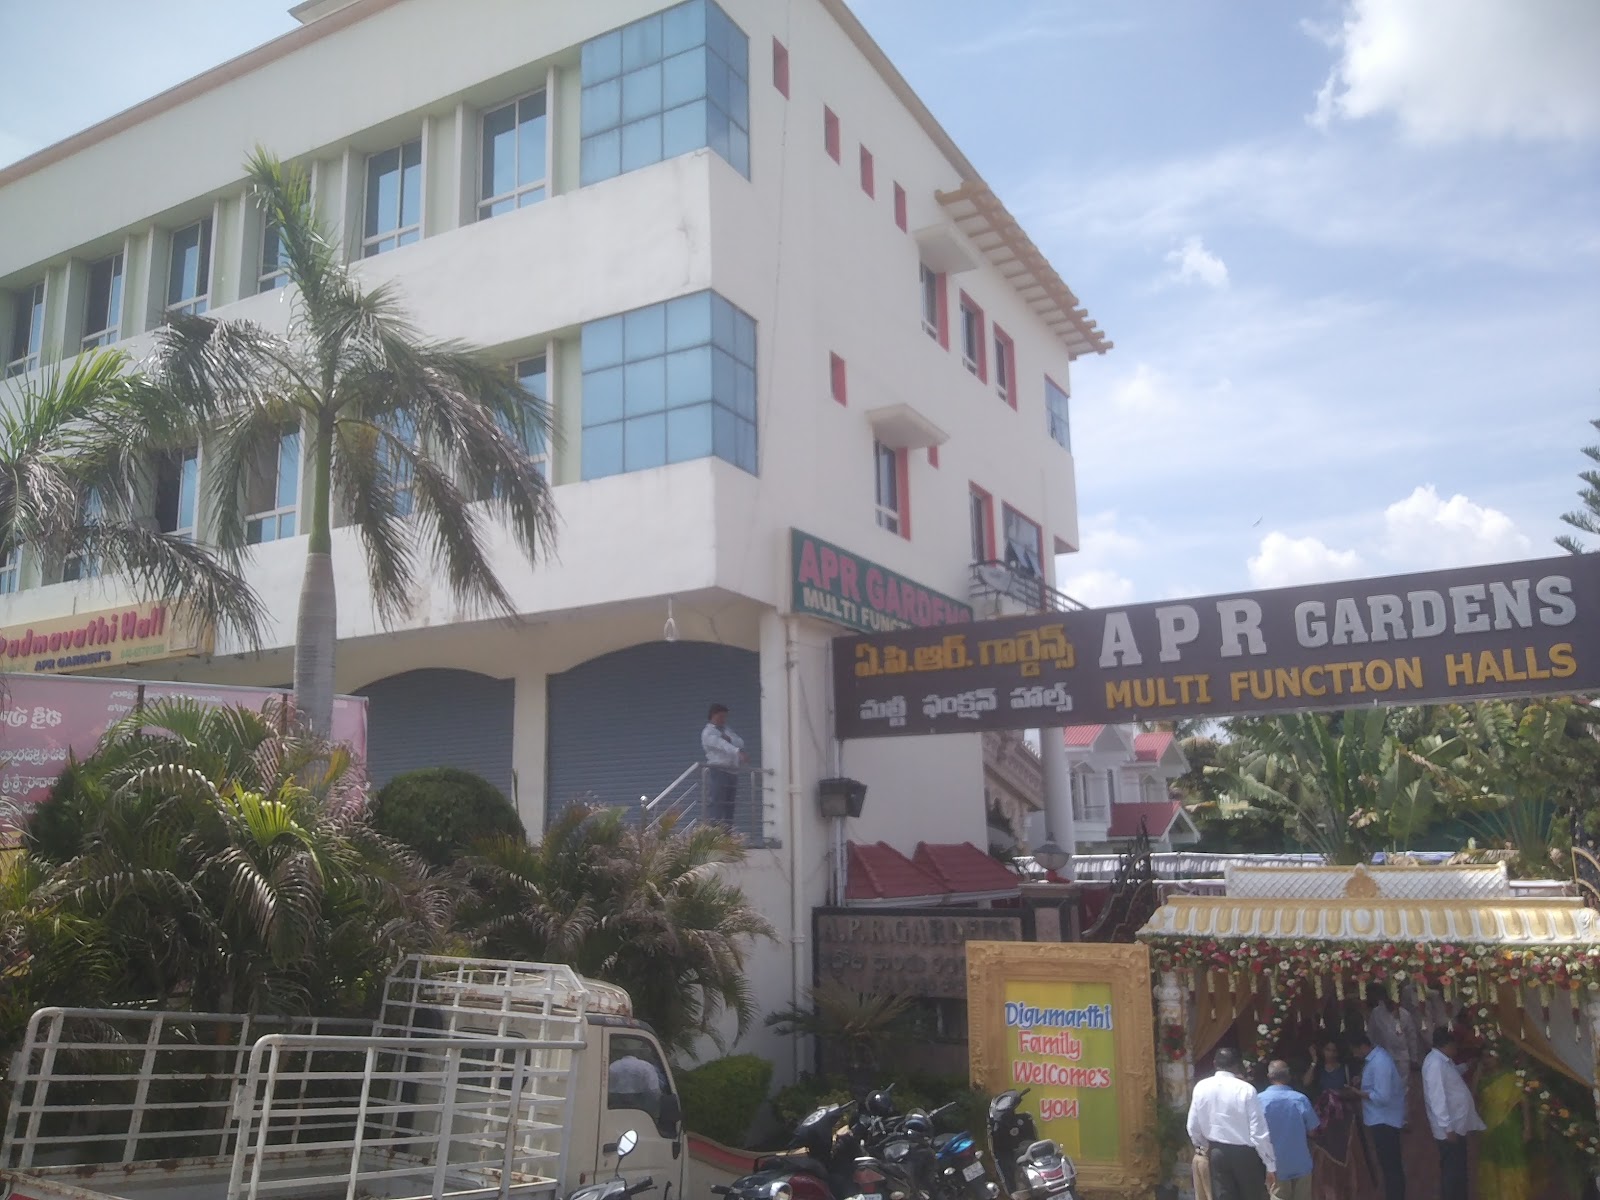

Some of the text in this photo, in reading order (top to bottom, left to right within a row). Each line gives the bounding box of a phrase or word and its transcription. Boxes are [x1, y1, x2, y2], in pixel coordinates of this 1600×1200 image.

[798, 541, 861, 603] APR
[802, 586, 857, 622] MULTI
[1295, 575, 1578, 649] GARDENS
[121, 606, 167, 641] Hall
[1105, 642, 1577, 710] MULTI FUNCTION HALLS
[1004, 1002, 1113, 1030] Digumarthi
[1018, 1030, 1082, 1061] Family
[1040, 1098, 1079, 1121] you
